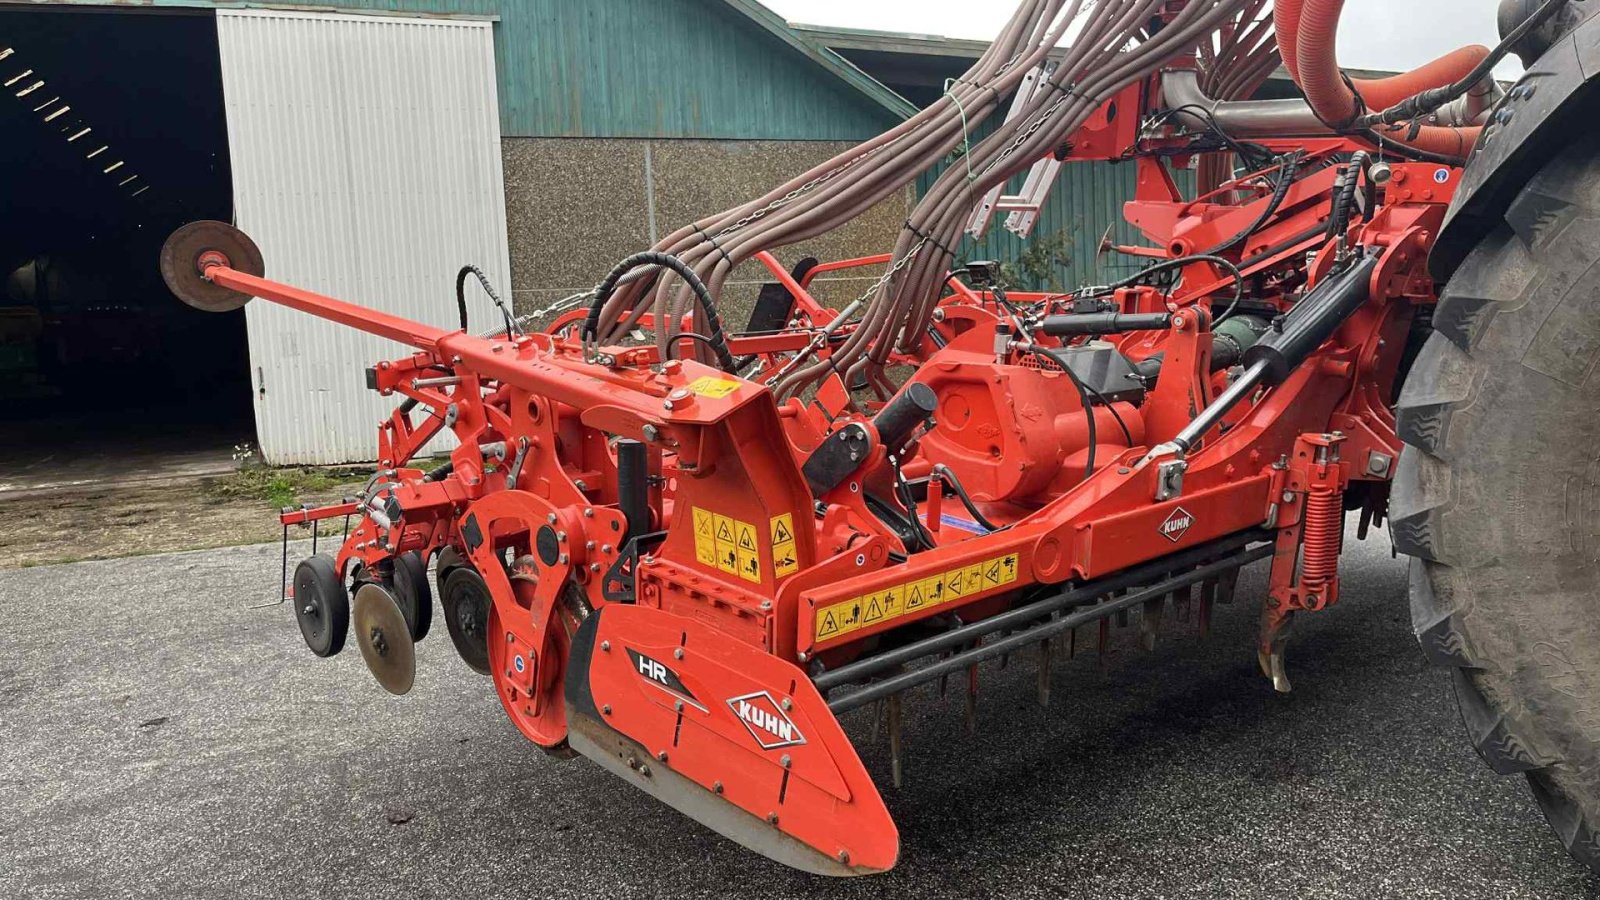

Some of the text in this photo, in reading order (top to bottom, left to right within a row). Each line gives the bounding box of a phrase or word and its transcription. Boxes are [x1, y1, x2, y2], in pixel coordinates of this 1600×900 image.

[1164, 516, 1190, 534] KUHN
[639, 655, 668, 685] HR
[739, 699, 792, 742] KUHN
